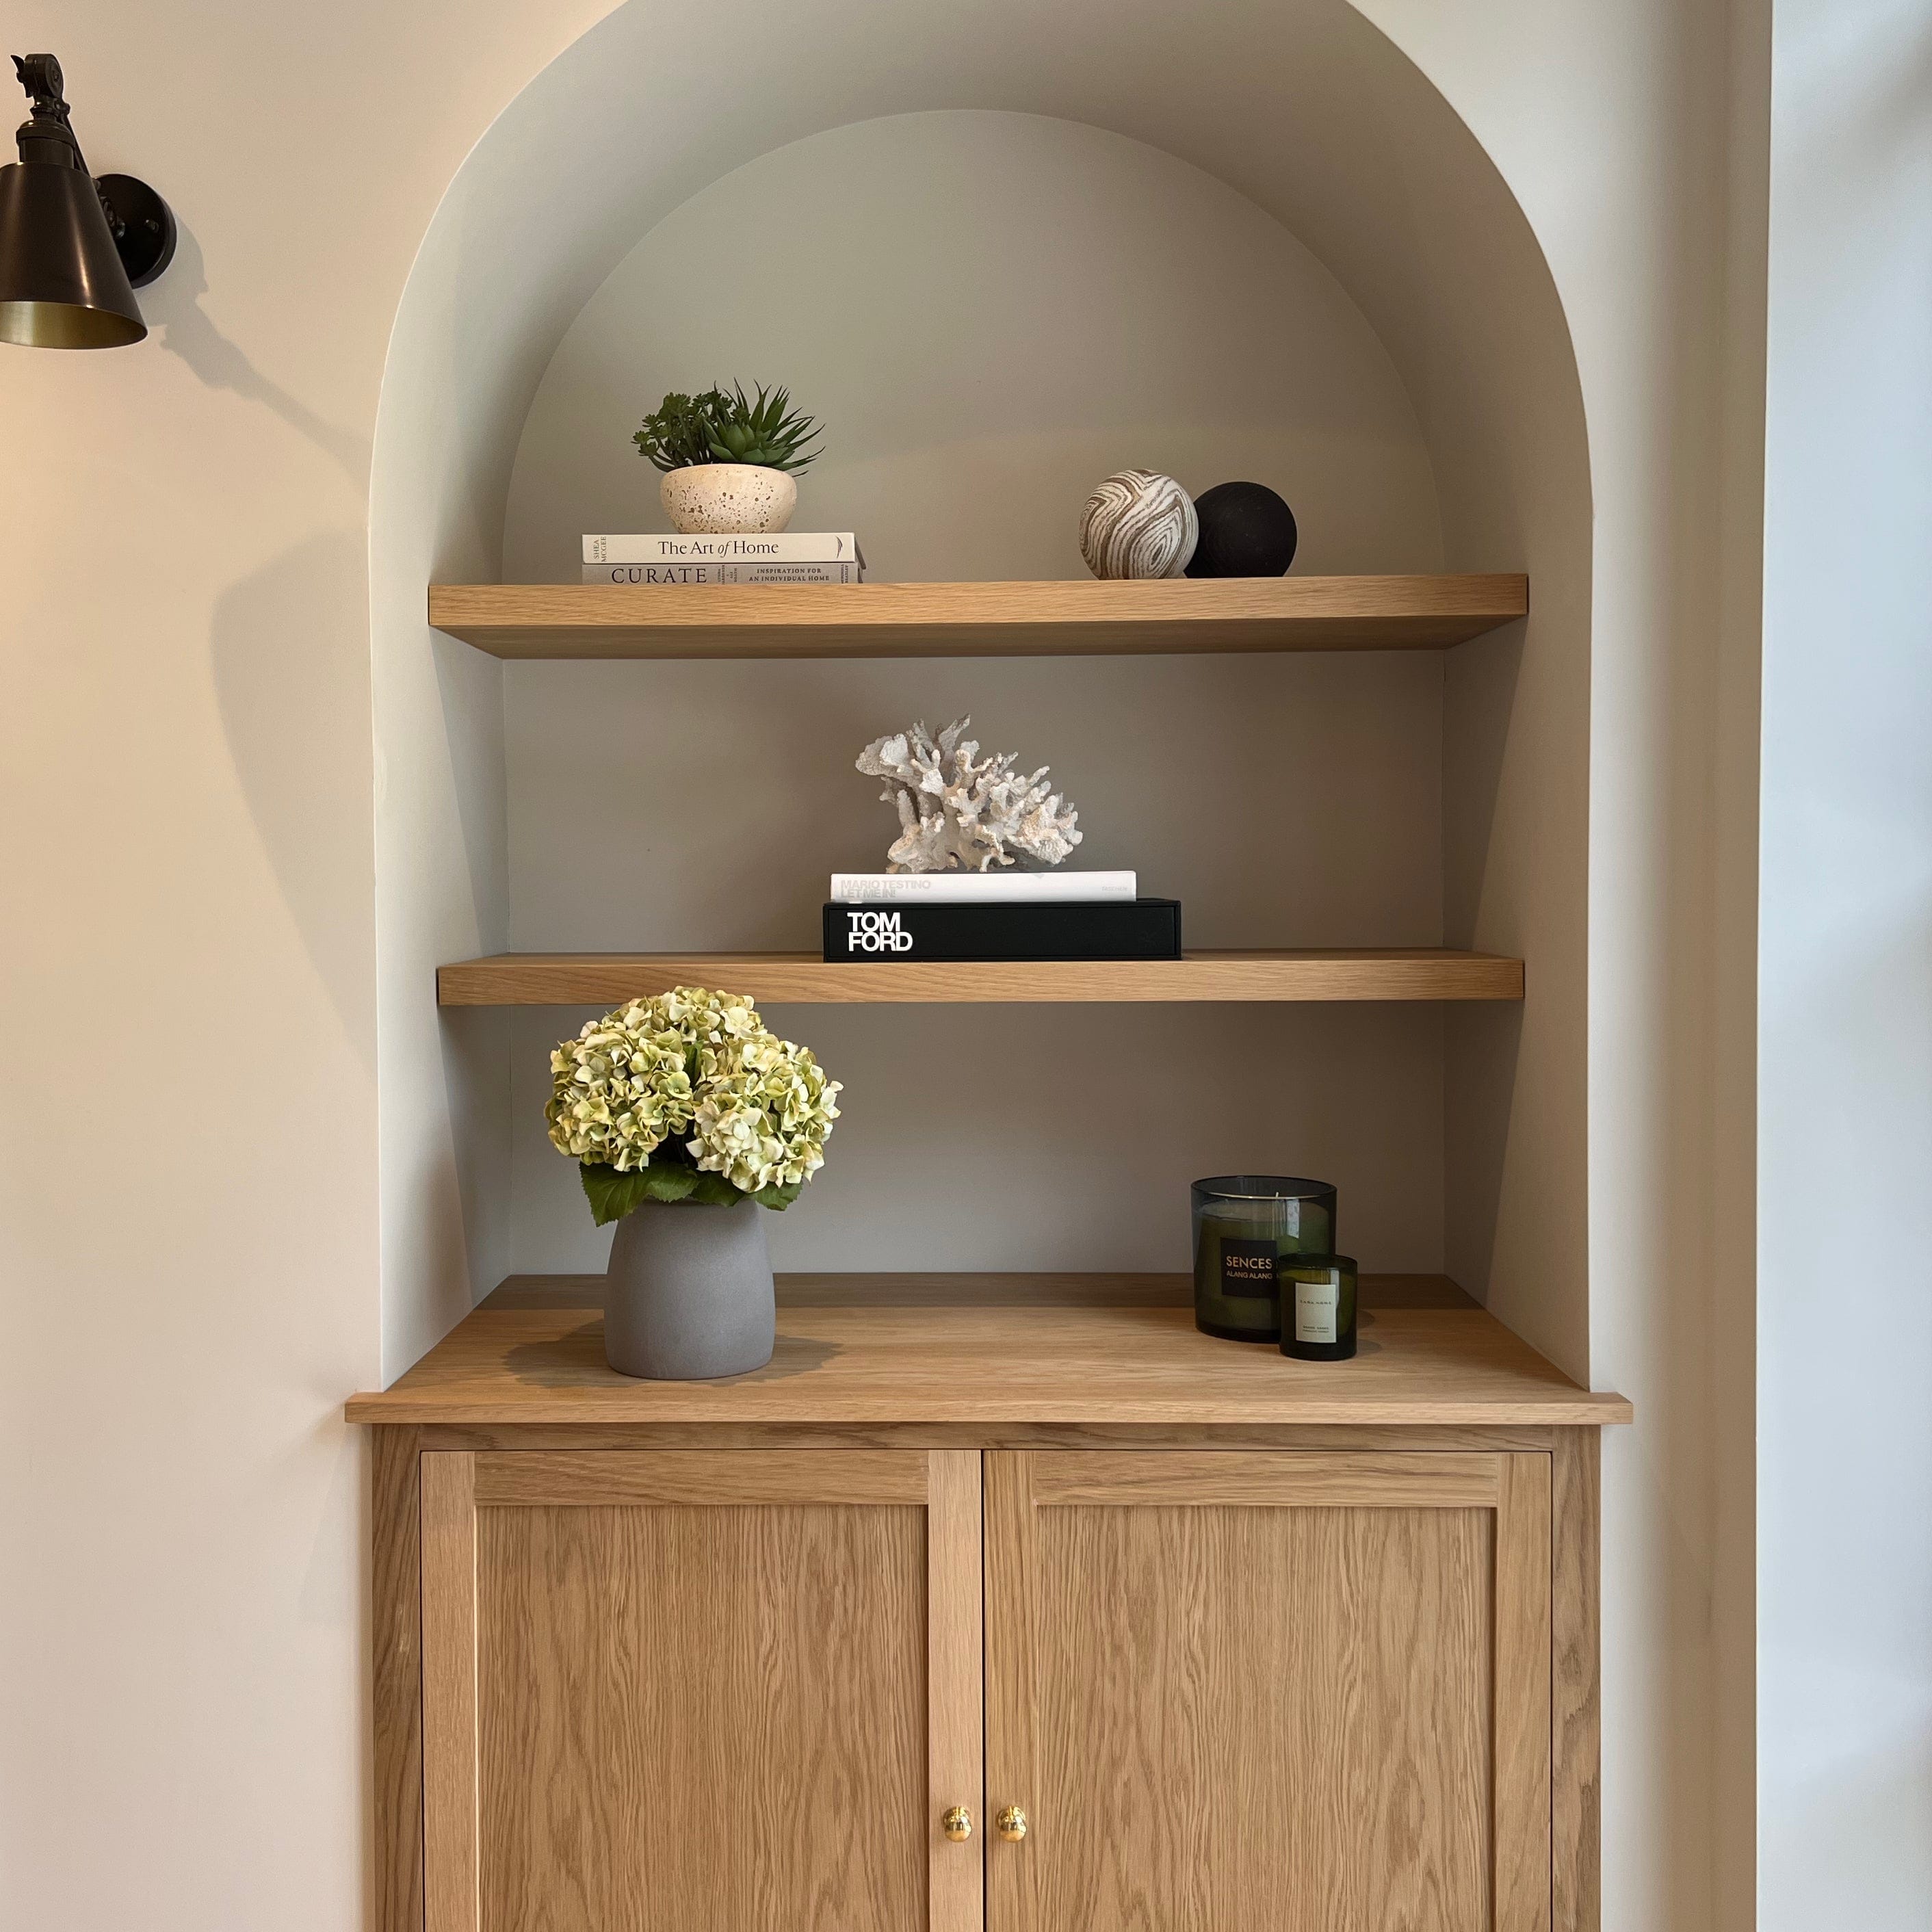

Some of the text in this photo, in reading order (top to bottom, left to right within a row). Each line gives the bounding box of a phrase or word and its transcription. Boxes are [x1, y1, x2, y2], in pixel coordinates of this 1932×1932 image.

[657, 540, 779, 558] The Art of Home
[612, 568, 707, 584] CURATE
[841, 880, 931, 889] MARIO TESTINO
[841, 889, 862, 898] LET
[863, 889, 881, 898] ME
[847, 911, 901, 932] TOM
[848, 931, 913, 952] FORD
[1226, 1255, 1272, 1269] SENCES
[1227, 1270, 1249, 1279] ALANG
